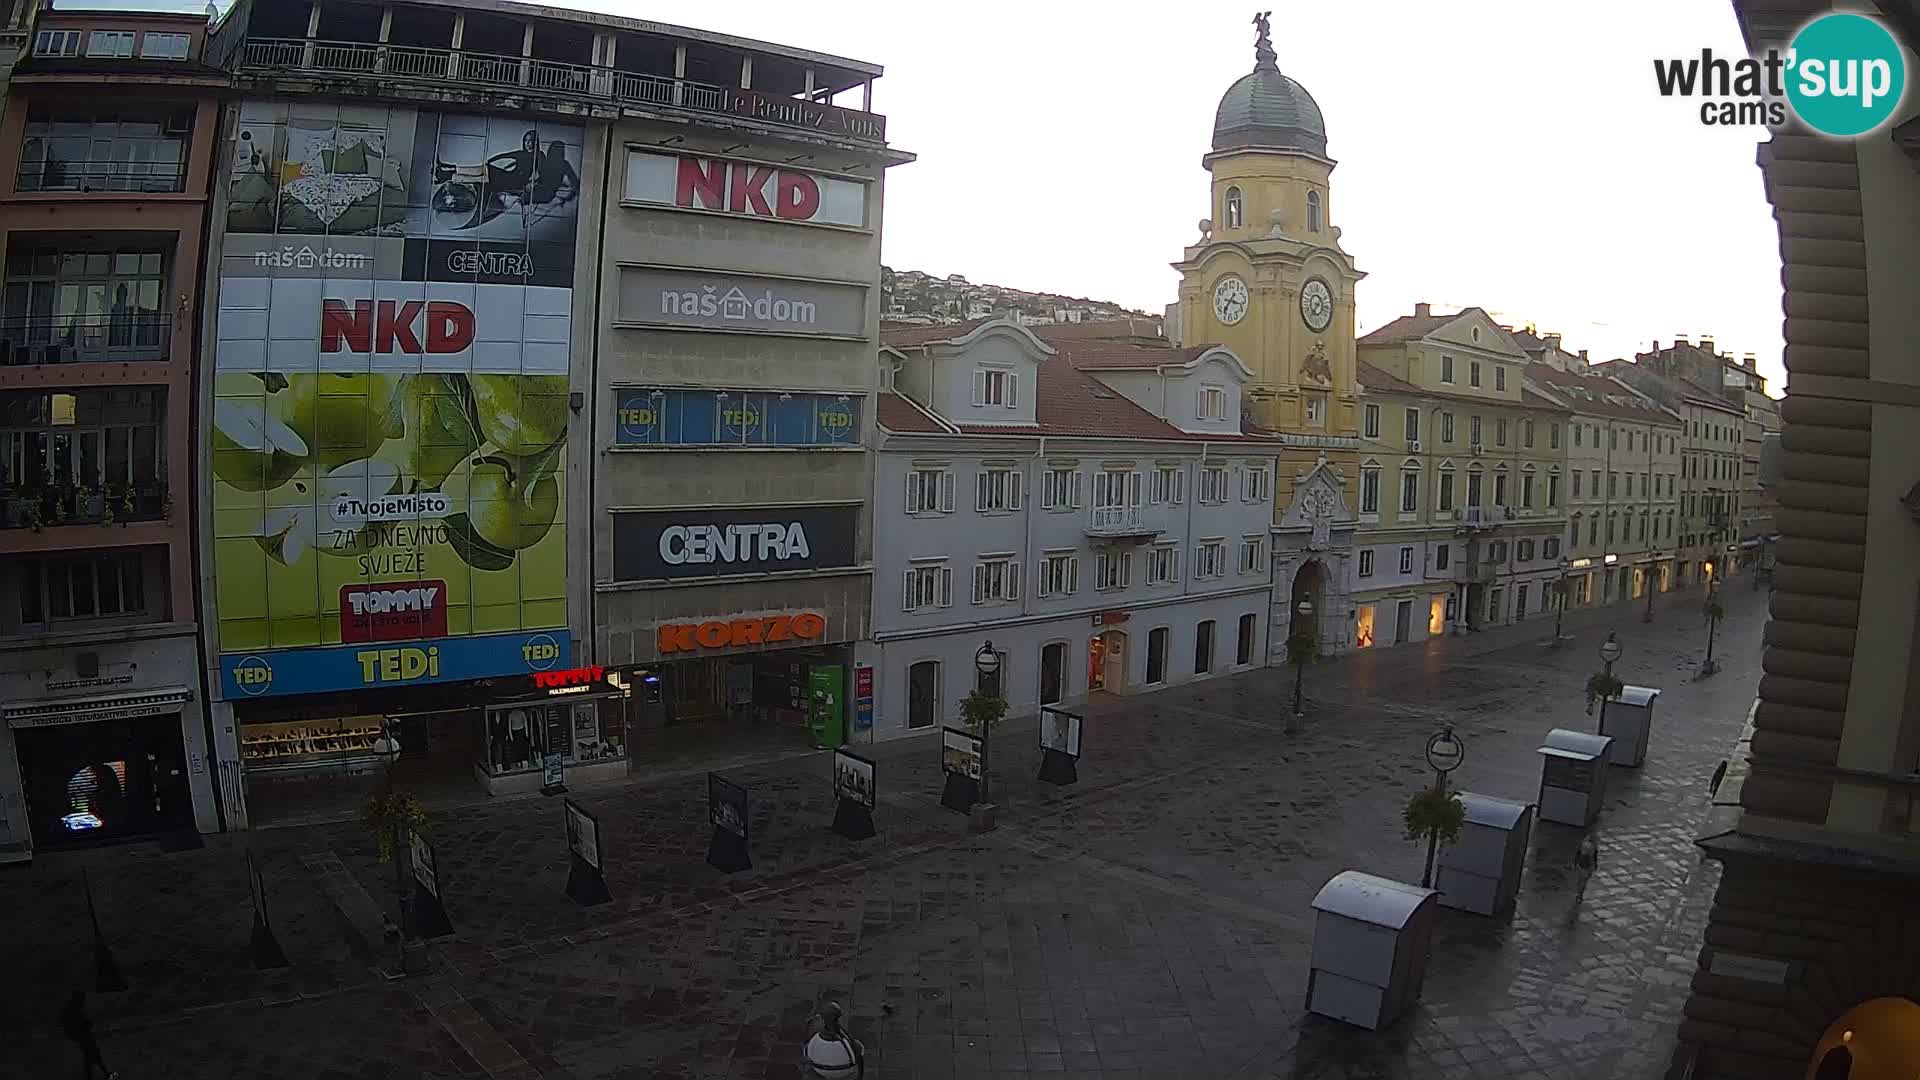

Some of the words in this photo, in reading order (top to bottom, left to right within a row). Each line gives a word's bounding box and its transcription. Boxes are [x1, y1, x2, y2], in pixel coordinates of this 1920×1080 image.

[722, 89, 745, 113] Le
[676, 158, 820, 221] NKD
[255, 245, 293, 267] naš
[318, 248, 365, 270] dom
[447, 250, 534, 276] CENTRA
[661, 284, 718, 317] naš
[754, 289, 816, 323] dom
[319, 298, 476, 354] NKD
[618, 407, 658, 425] TEDi
[723, 409, 760, 427] TEDi
[819, 411, 853, 429] TEDi
[337, 496, 446, 517] #TvojeMisto
[332, 528, 357, 550] ZA
[366, 524, 450, 548] DNEVNO
[659, 522, 810, 565] CENTRA
[358, 551, 426, 576] SVJEŽE
[348, 587, 438, 615] TOMMY
[658, 615, 826, 652] KORZO
[357, 647, 440, 682] TEDi
[521, 643, 560, 662] TEDi
[233, 667, 273, 684] TEDi
